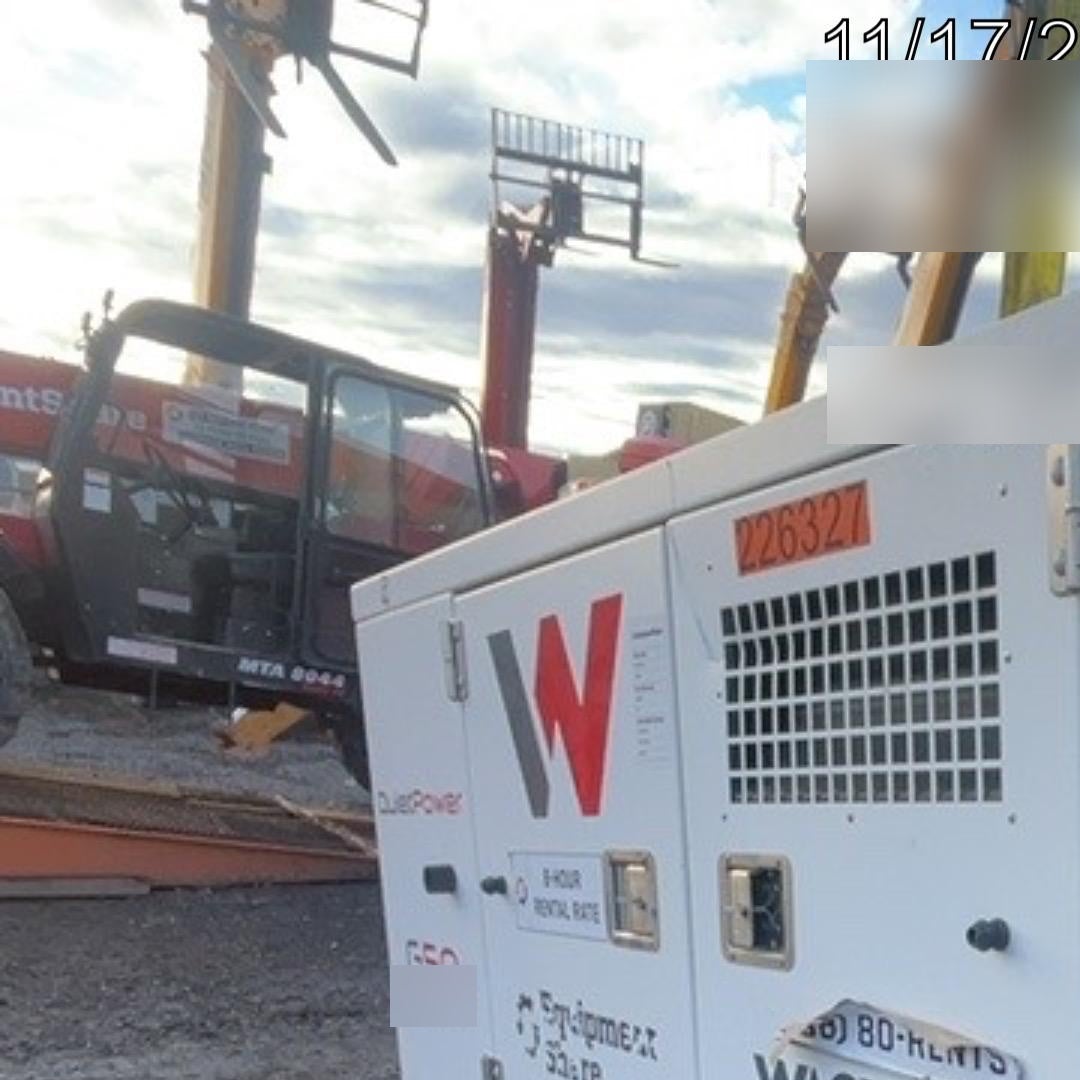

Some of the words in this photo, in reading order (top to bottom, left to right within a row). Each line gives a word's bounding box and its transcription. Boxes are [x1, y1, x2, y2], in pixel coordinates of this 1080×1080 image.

[736, 481, 870, 574] 226327
[239, 657, 285, 679] MTA
[533, 896, 571, 922] RENTAL
[572, 899, 602, 925] RATE
[540, 988, 658, 1062] Equipment
